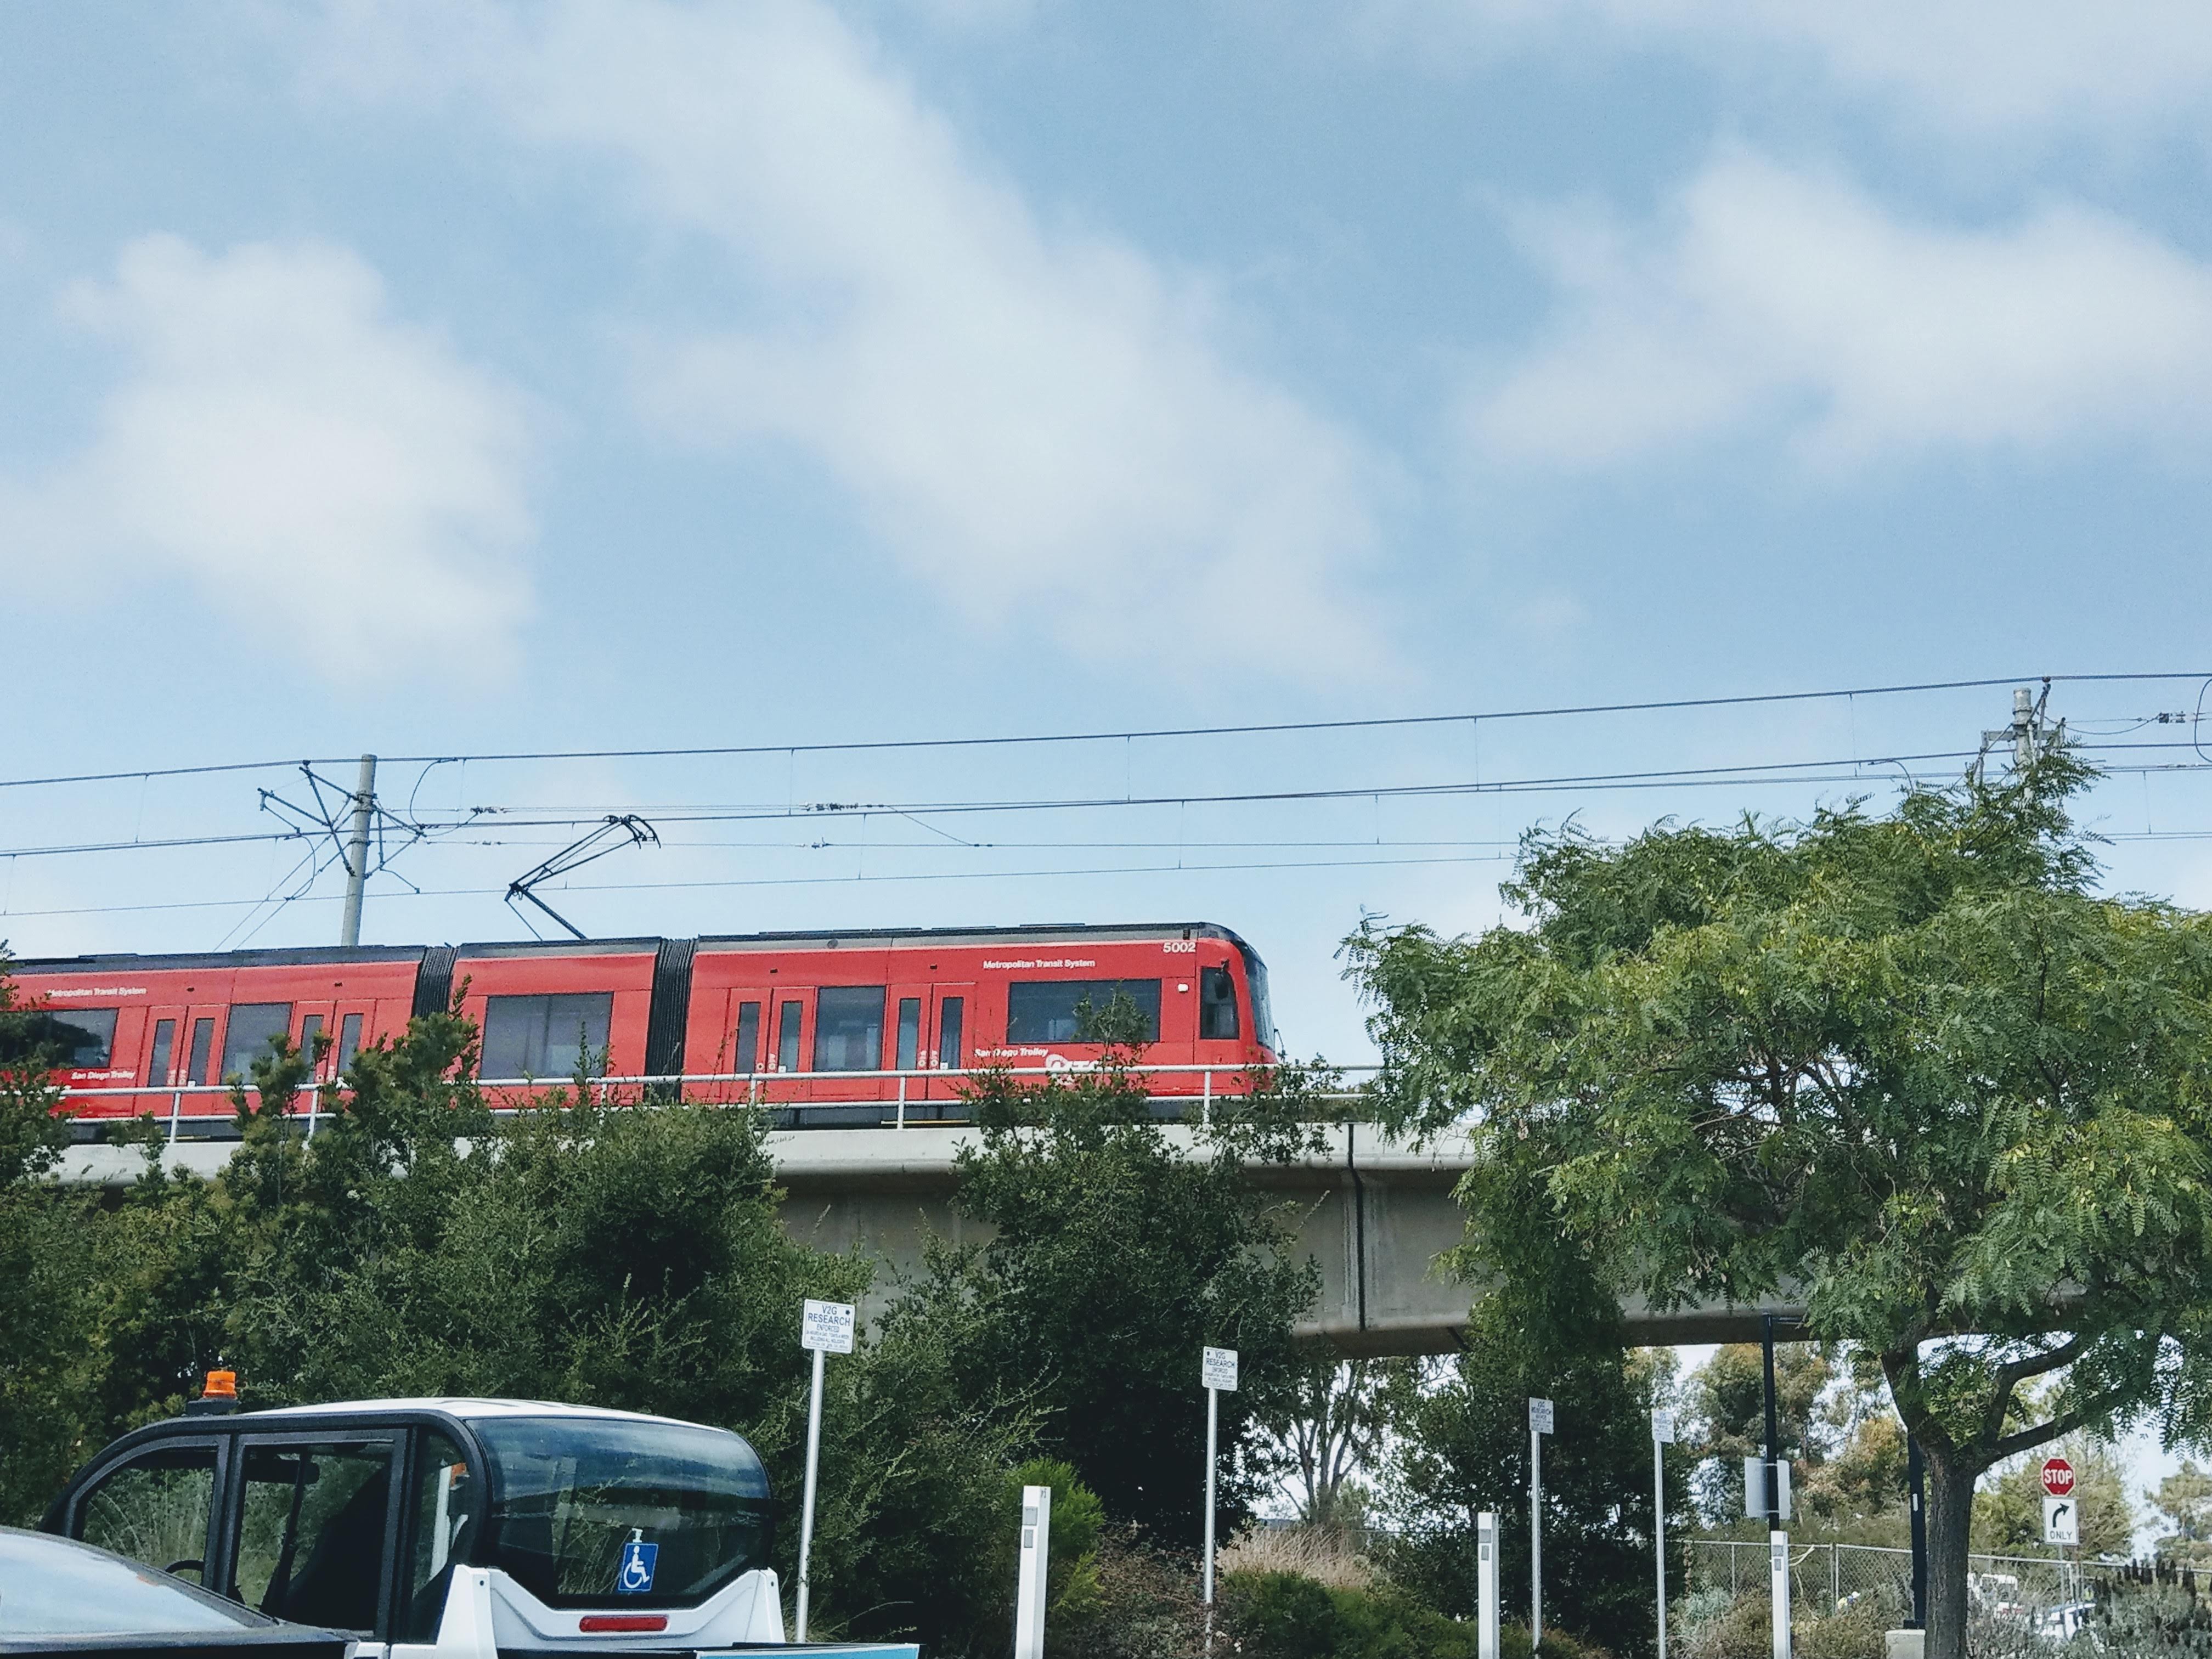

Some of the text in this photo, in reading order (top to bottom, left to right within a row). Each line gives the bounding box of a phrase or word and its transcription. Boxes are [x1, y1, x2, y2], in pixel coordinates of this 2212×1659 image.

[1163, 942, 1196, 953] 5002
[983, 960, 1096, 969] Metropolitan Transit System
[94, 988, 118, 996] Transit
[119, 987, 147, 996] System
[992, 1048, 1018, 1058] Dego
[1019, 1047, 1048, 1058] Trolley
[71, 1070, 136, 1080] San Diego Trolley
[822, 1305, 837, 1314] V2G
[808, 1313, 851, 1327] RESEARCH
[1206, 1358, 1235, 1369] RESEARCH
[2044, 1468, 2073, 1485] STOP
[2050, 1531, 2072, 1540] ONLY
